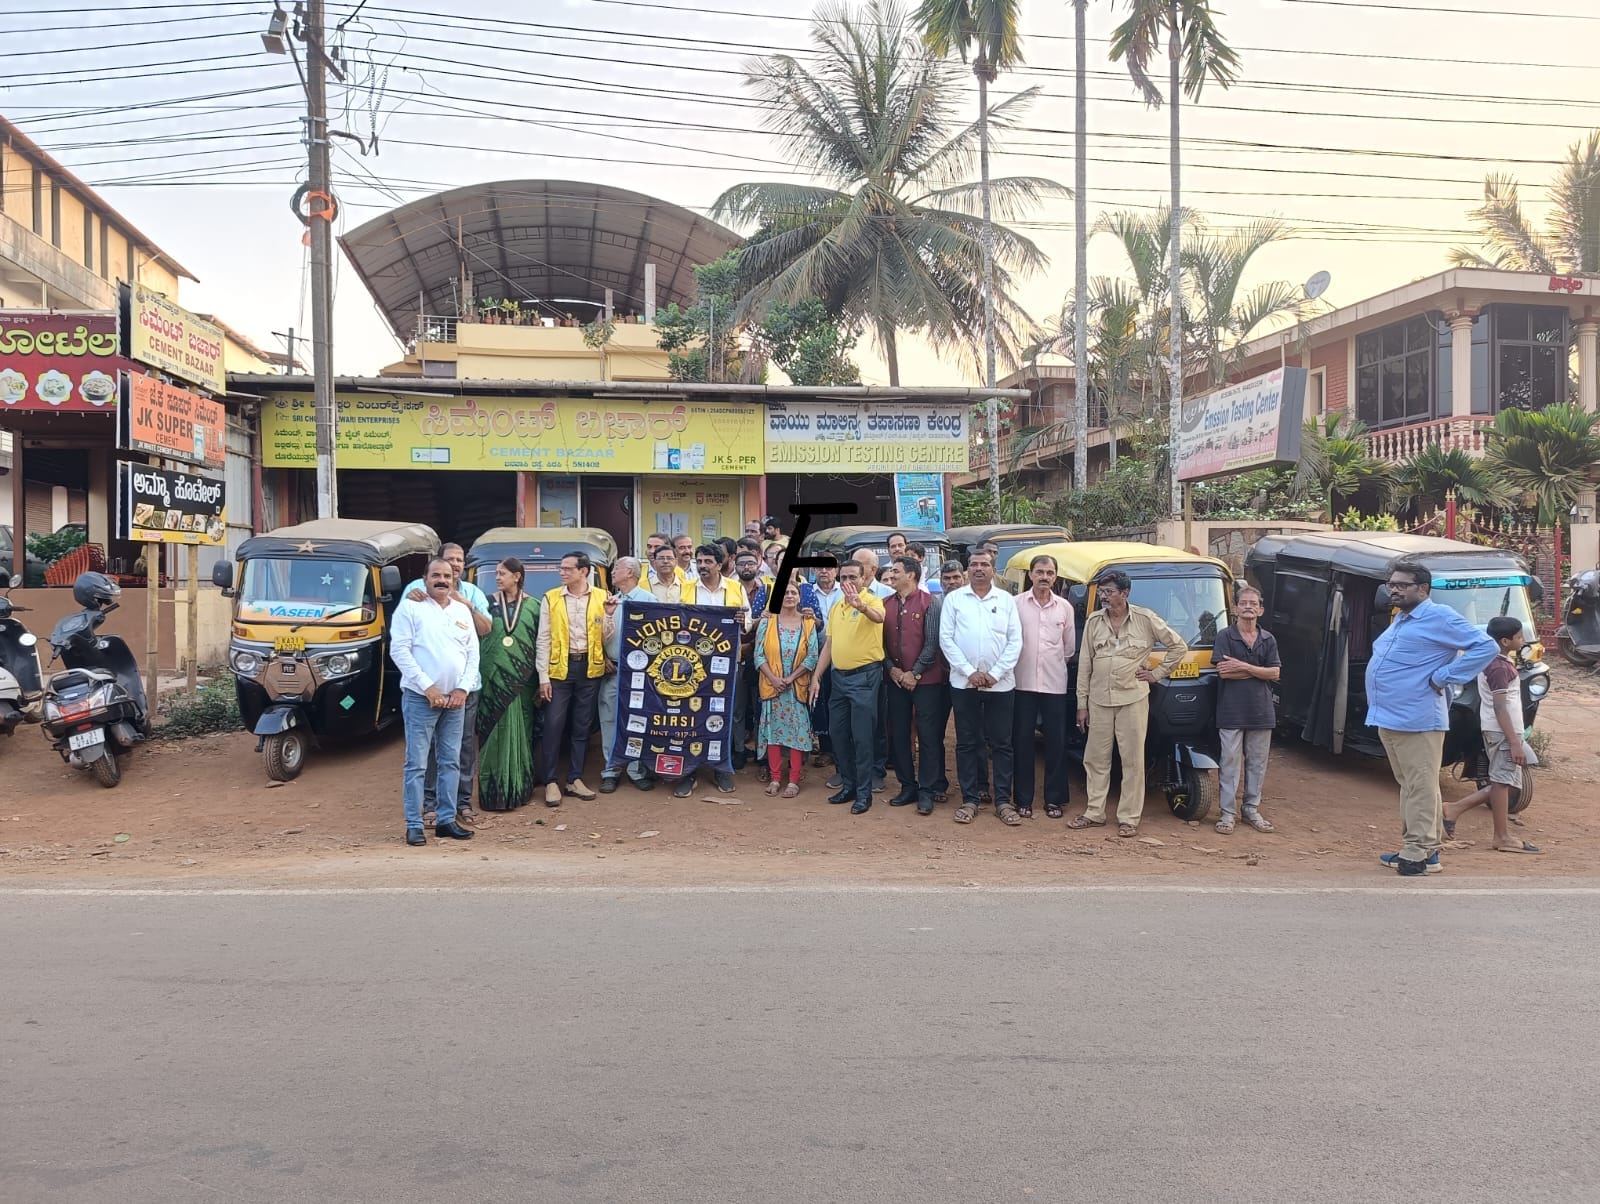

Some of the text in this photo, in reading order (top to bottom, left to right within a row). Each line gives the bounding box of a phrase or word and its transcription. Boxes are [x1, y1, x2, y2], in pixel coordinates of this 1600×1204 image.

[149, 335, 183, 362] CEMENT
[185, 352, 214, 376] BAZAAR
[188, 332, 220, 360] ಬಜಾರ್
[1231, 396, 1254, 423] Testing
[1255, 391, 1279, 415] Center
[137, 406, 193, 439] JK SUPER
[357, 416, 400, 424] ENTERPRISES
[421, 399, 689, 440] ಸಿಮೆಂಟ್ ಬಜಾರ್
[769, 409, 961, 440] ವಾಯು ಮಾಲಿನ್ಯ ತಪಾಸಣಾ ಕೇಂದ್ರ
[155, 433, 178, 447] CEMENT
[489, 446, 615, 459] CEMENT BAZAAR
[712, 455, 724, 464] JK
[769, 444, 963, 463] EMISSION TESTING CENTRE
[268, 605, 326, 618] YASEEN
[627, 615, 731, 653] LIONS CLUB
[663, 647, 697, 661] LIONS
[670, 662, 687, 681] L
[653, 714, 695, 728] SIRSI
